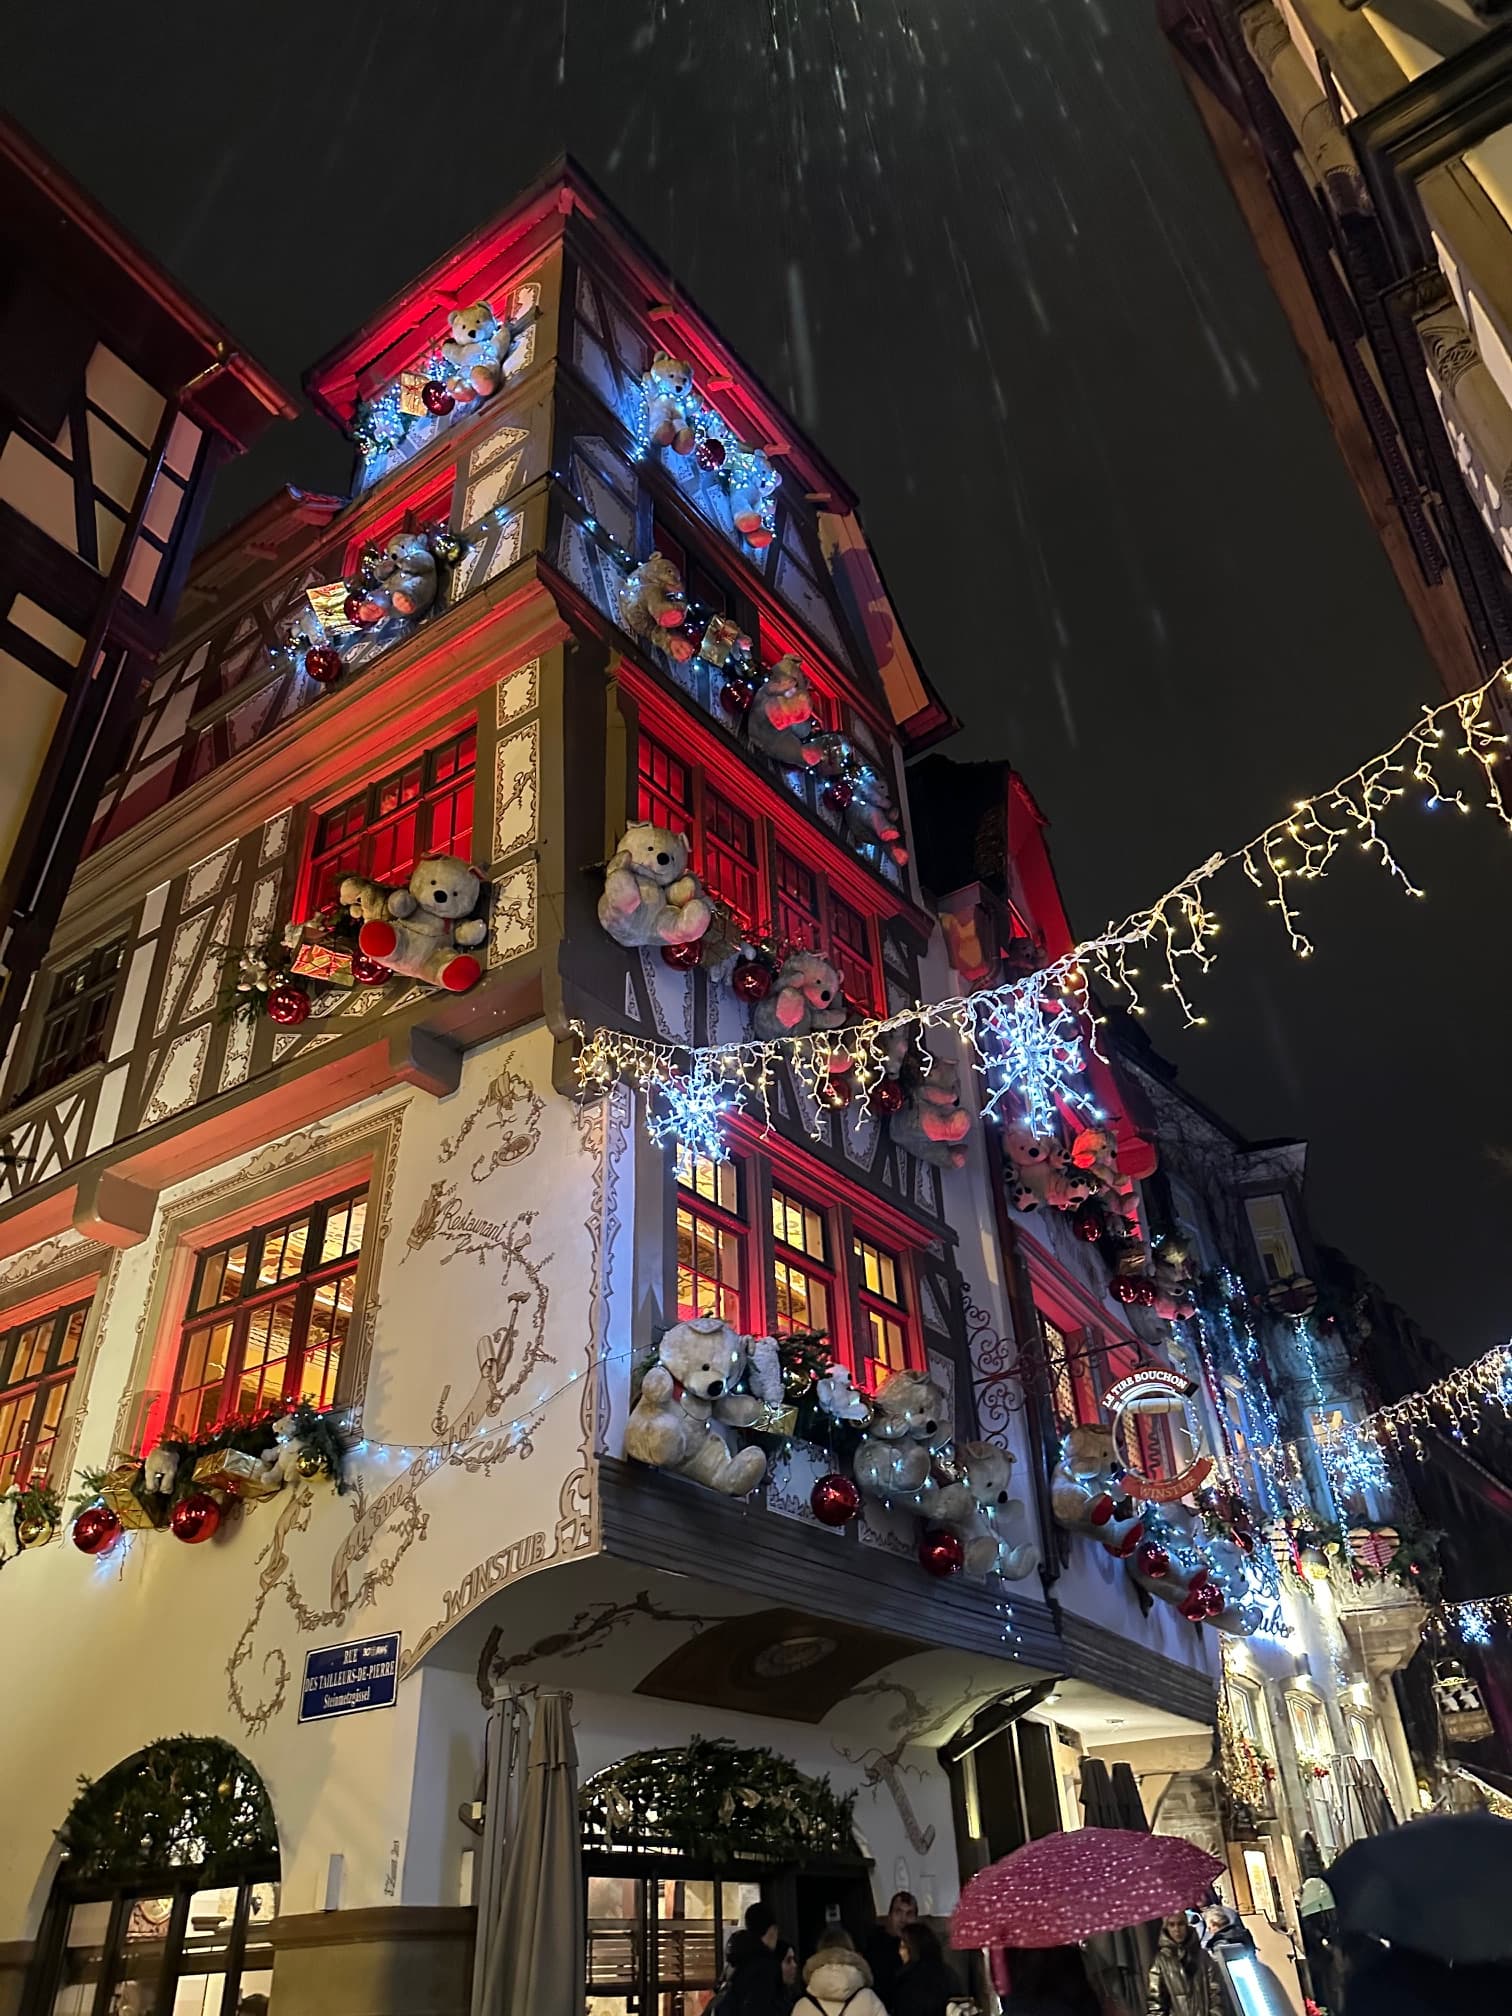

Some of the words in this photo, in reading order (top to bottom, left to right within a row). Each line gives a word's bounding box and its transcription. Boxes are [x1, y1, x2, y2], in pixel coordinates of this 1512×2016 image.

[431, 1198, 508, 1242] Restaurant
[1102, 1394, 1115, 1408] LE
[1110, 1377, 1135, 1396] TIRE
[1133, 1370, 1188, 1389] BOUCHON
[1139, 1475, 1196, 1499] WINSTUB
[443, 1531, 546, 1618] WINSTUB
[304, 1676, 318, 1692] DES
[319, 1660, 395, 1690] TAILLEURS-DE-PIERRE
